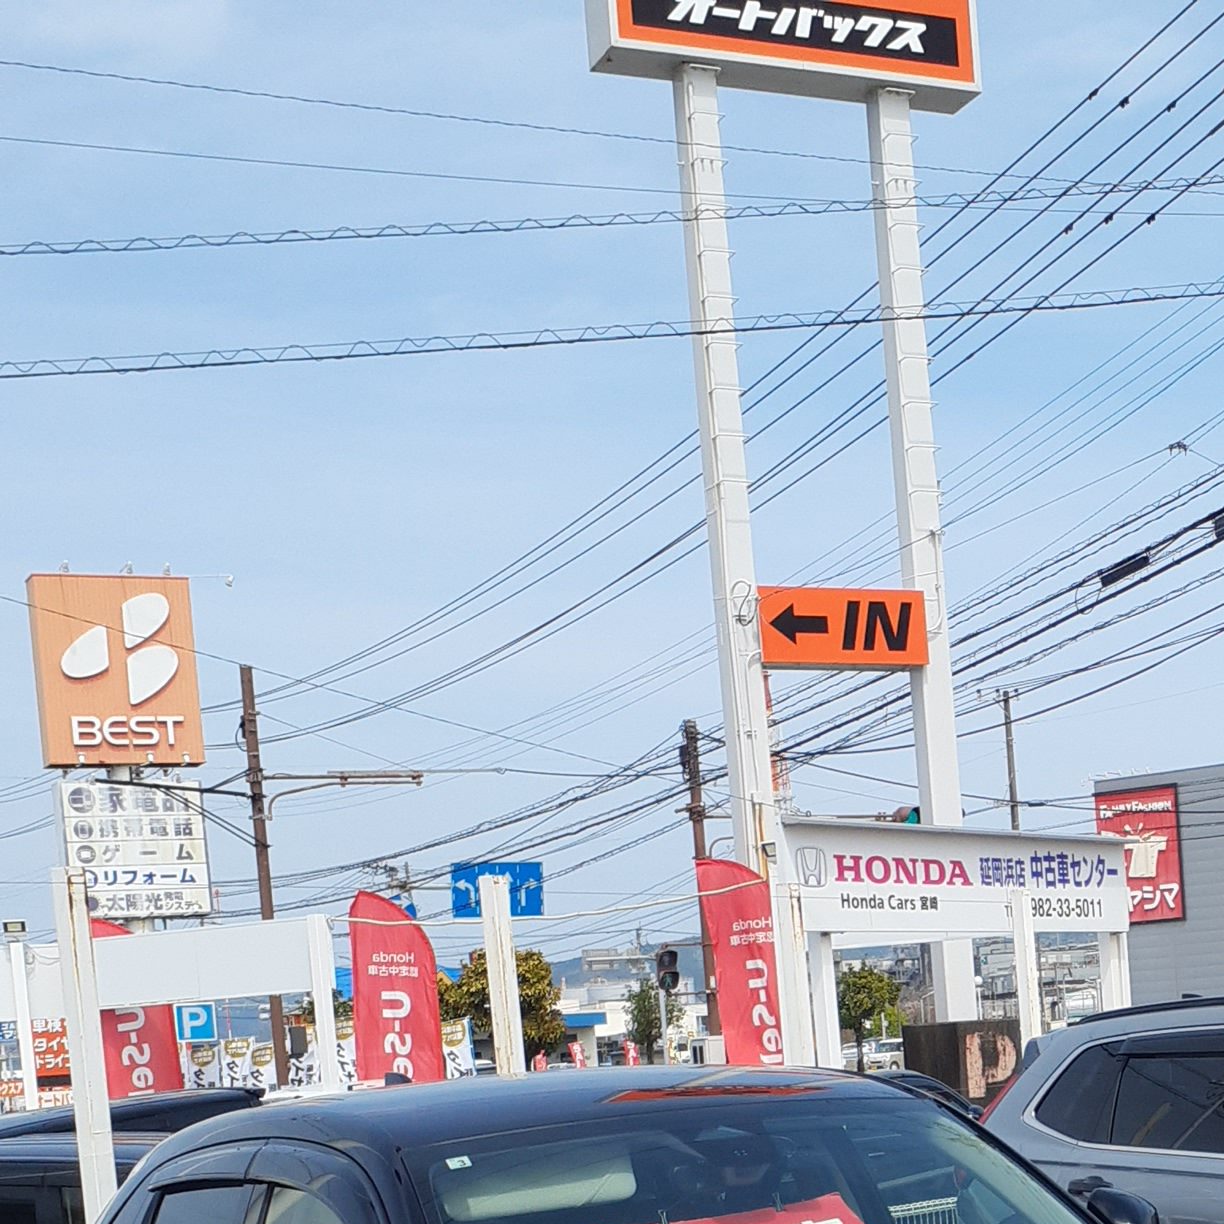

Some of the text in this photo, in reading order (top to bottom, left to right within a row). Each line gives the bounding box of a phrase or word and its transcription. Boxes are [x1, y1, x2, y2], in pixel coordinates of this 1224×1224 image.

[842, 600, 913, 651] IN
[71, 716, 184, 746] BEST
[104, 868, 196, 886] リフォーム
[833, 854, 974, 886] HONDA
[1030, 850, 1119, 889] 中古車センター
[841, 893, 885, 910] Honda
[888, 894, 916, 911] Cars
[182, 1007, 207, 1039] P
